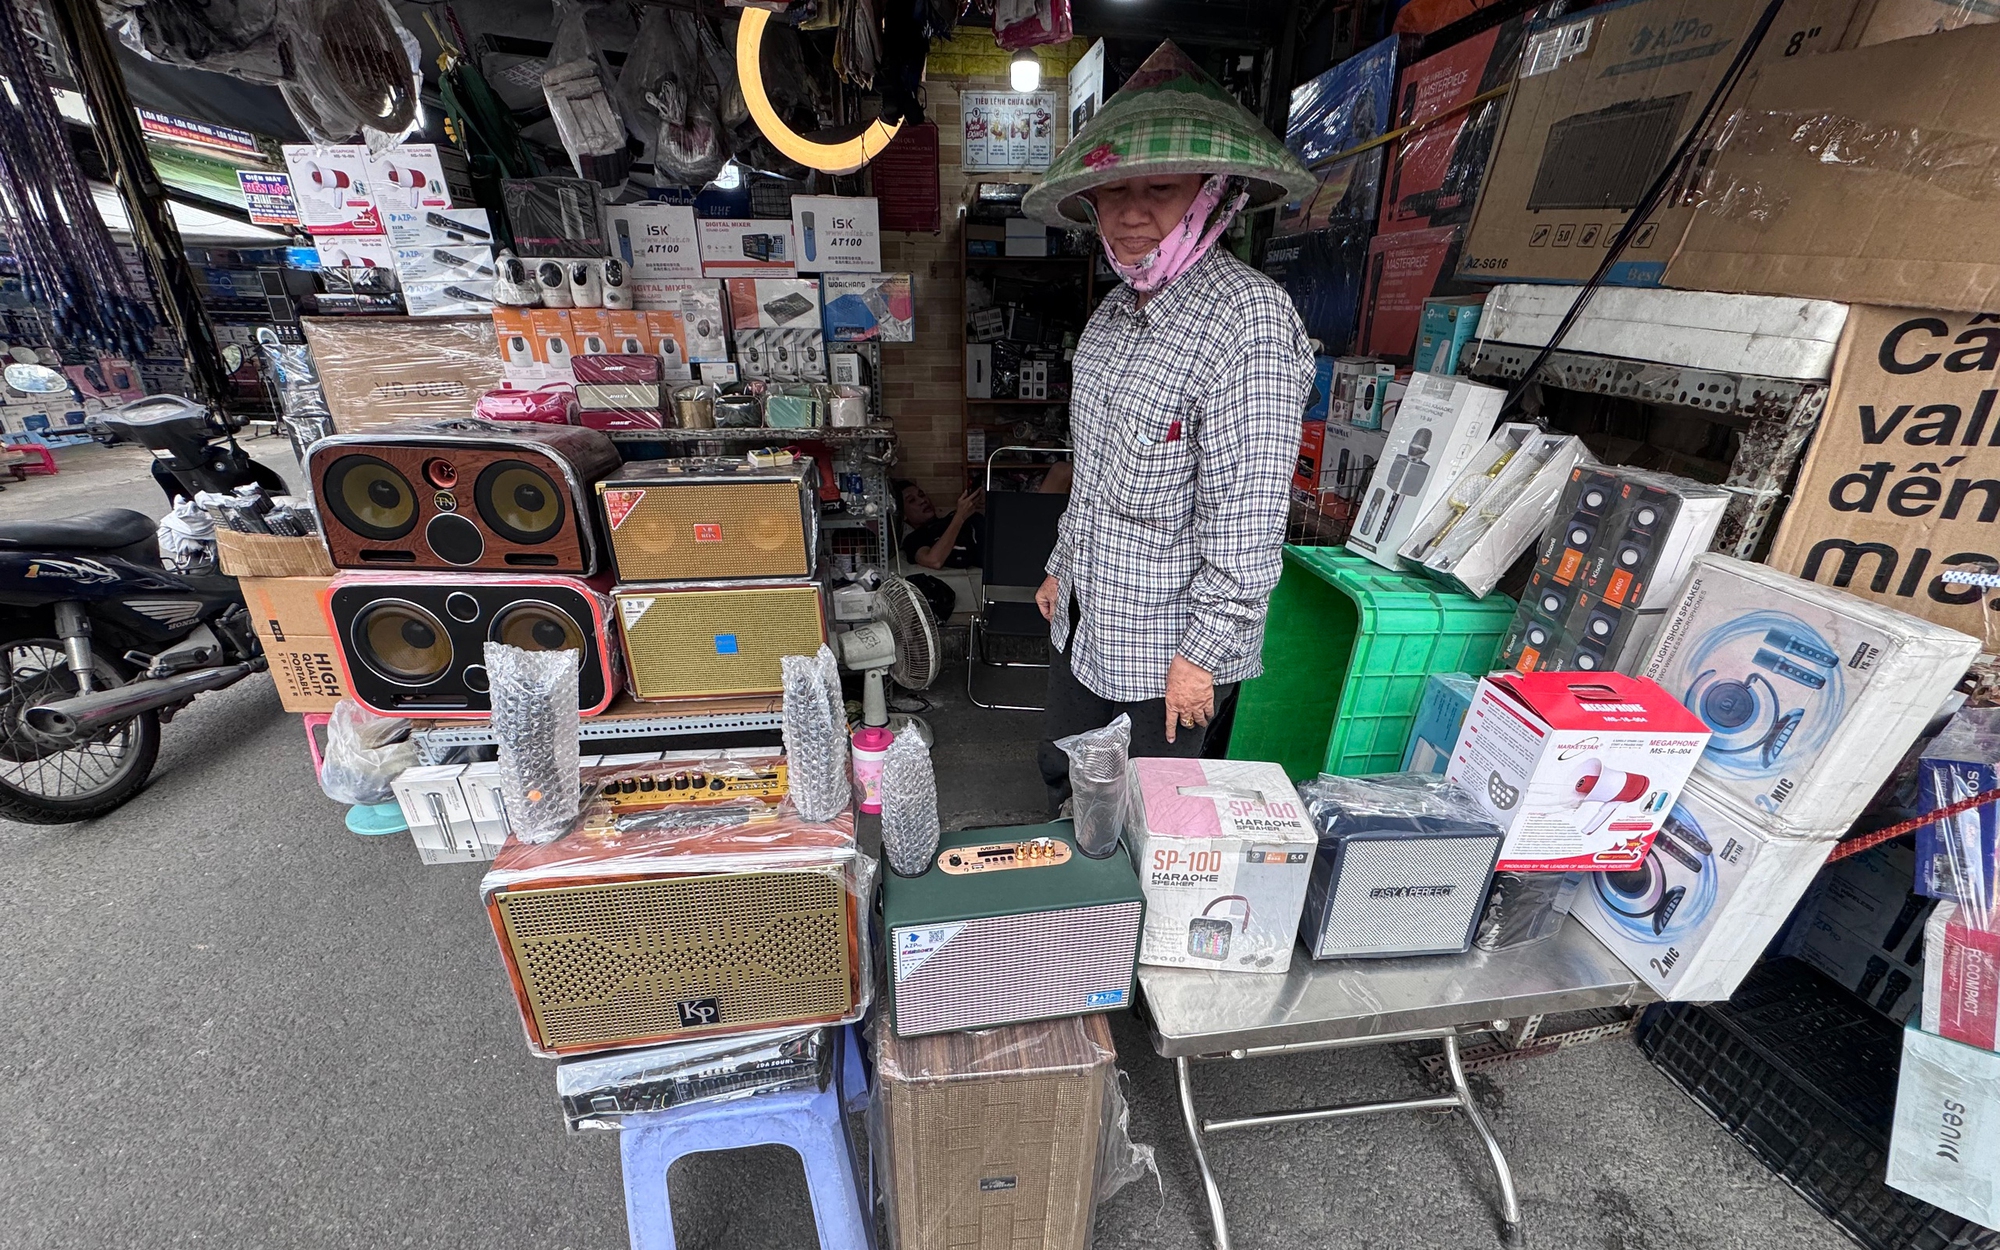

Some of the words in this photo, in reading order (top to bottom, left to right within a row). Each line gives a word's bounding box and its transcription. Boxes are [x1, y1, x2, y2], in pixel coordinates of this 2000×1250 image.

[1651, 18, 1713, 50] AZPro
[1784, 26, 1822, 58] 8"
[1420, 69, 1469, 98] MASTERPIECE
[142, 110, 156, 121] LOA
[174, 119, 187, 129] LOA
[646, 224, 669, 236] iSK
[832, 217, 854, 230] iSK
[830, 238, 863, 248] AT100
[1557, 229, 1571, 243] 5.0
[647, 244, 680, 254] AT100
[1266, 247, 1300, 261] SHURE
[1386, 255, 1429, 270] MASTERPIECE
[1464, 257, 1509, 270] AZ-SG16
[1828, 456, 2000, 523] đến
[1545, 537, 1557, 559] Kisonli
[1565, 556, 1576, 575] V400
[1592, 556, 1605, 579] Kisonli
[1613, 578, 1625, 597] V400
[167, 617, 200, 631] HONDA
[1657, 616, 1683, 665] LIGHTSHOW
[1679, 577, 1703, 618] SPEAKER
[1664, 637, 1684, 672] WIRELESS
[1680, 589, 1707, 640] MICROPHONES
[1506, 634, 1518, 653] Kisonli
[1522, 653, 1533, 672] V400
[1858, 647, 1880, 670] YS-110
[278, 652, 299, 697] SPEAKER
[289, 652, 312, 697] PORTABLE
[302, 653, 325, 697] QUALITY
[313, 653, 342, 697] HIGH
[1579, 703, 1648, 713] MEGAPHONE
[1602, 715, 1649, 723] MS-16-004
[1556, 743, 1600, 751] MARKETSTAR
[1648, 739, 1700, 747] MEGAPHONE
[1649, 747, 1692, 755] MS-16-004
[1755, 793, 1780, 815] 2
[1770, 777, 1795, 804] MIC
[1229, 800, 1298, 819] SP-100
[1233, 818, 1303, 828] KARAOKE
[1153, 849, 1222, 873] SP-100
[1290, 853, 1304, 861] 5.0
[1728, 843, 1745, 865] YS-110
[1151, 872, 1219, 883] KARAOKE
[1151, 879, 1195, 887] SPEAKER
[1371, 888, 1399, 900] EASY
[1399, 887, 1408, 899] &
[1408, 886, 1455, 898] PERFECT
[1649, 957, 1669, 979] 2
[1661, 946, 1681, 970] MIC
[1963, 962, 1982, 1017] COMPACT
